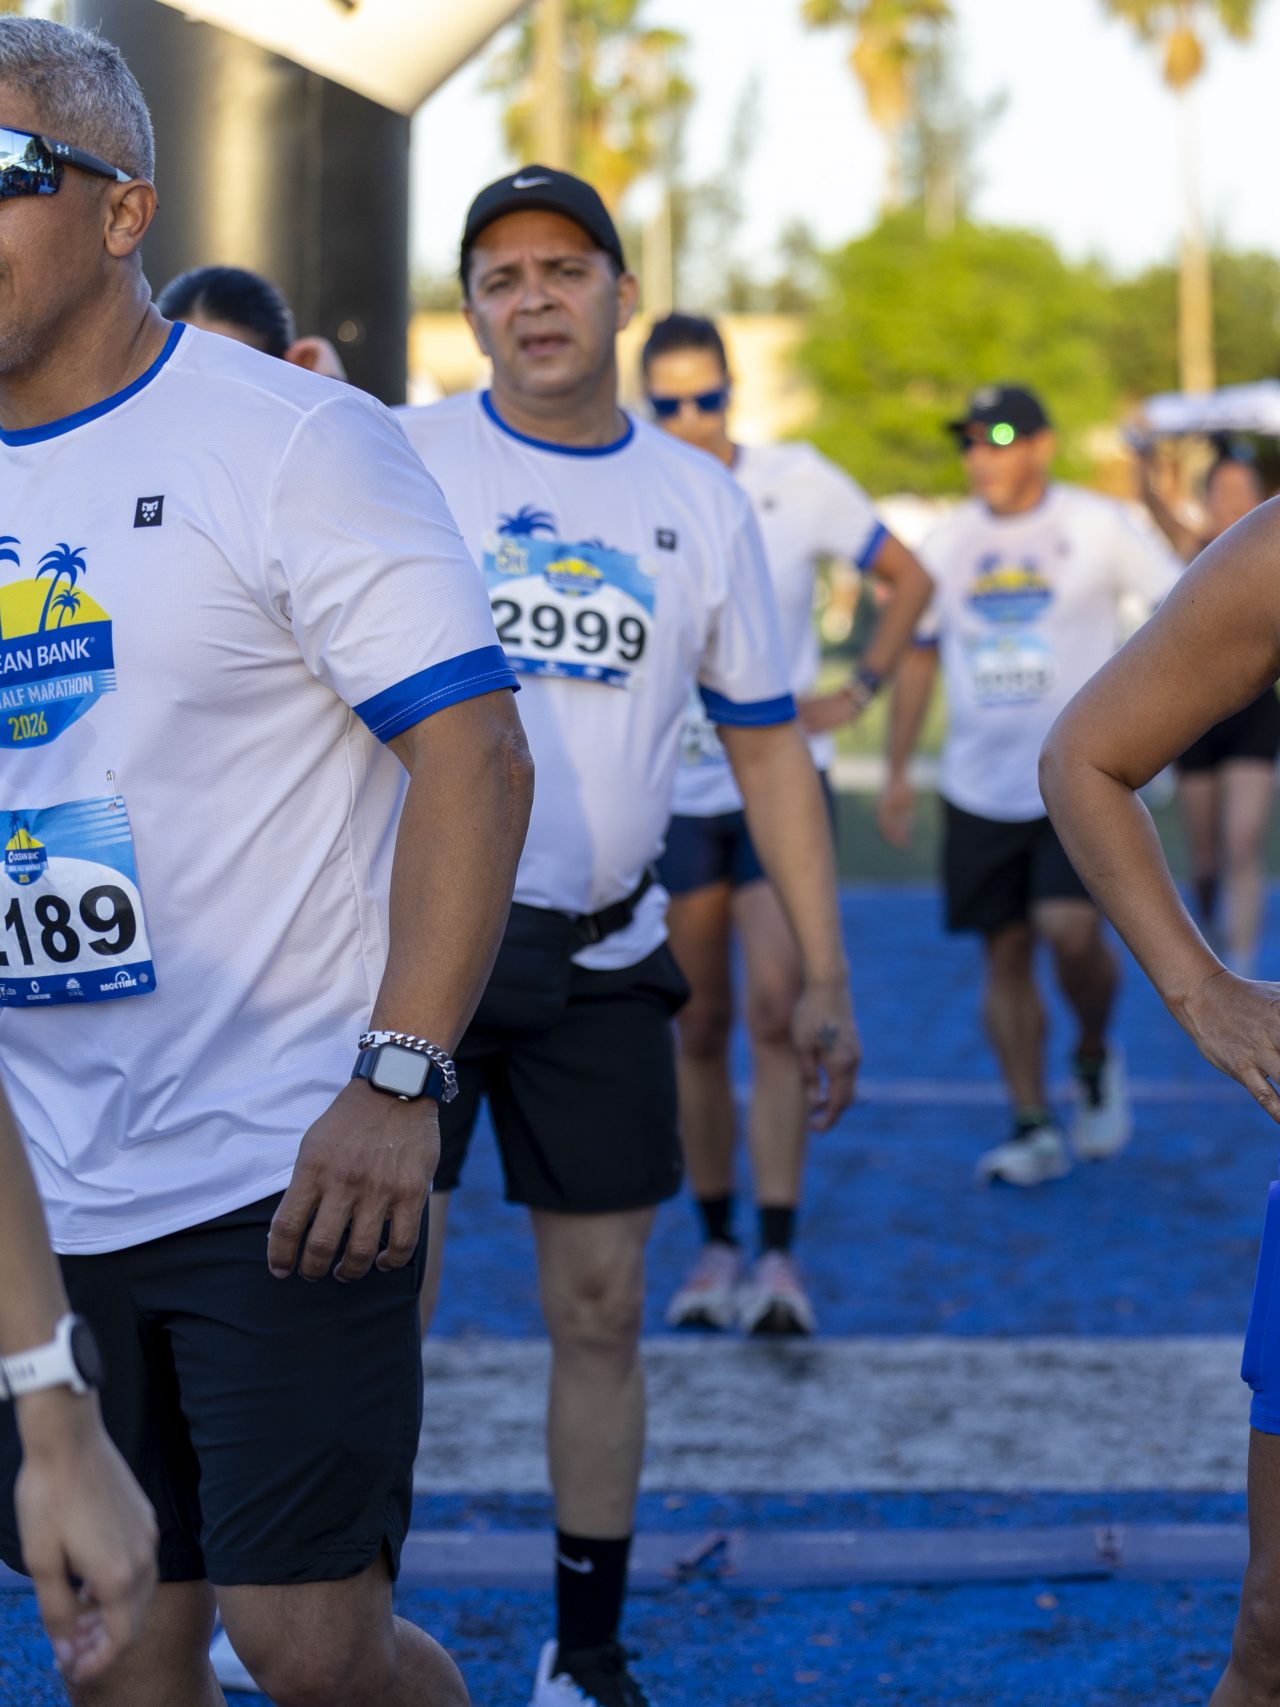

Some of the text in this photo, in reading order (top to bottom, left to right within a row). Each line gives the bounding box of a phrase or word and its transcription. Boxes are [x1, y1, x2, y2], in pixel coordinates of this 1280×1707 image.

[490, 599, 646, 662] 2999
[0, 637, 90, 674] AN BANK
[0, 675, 94, 710] ALF MARATHON
[8, 711, 48, 741] 2026
[0, 884, 137, 967] 189
